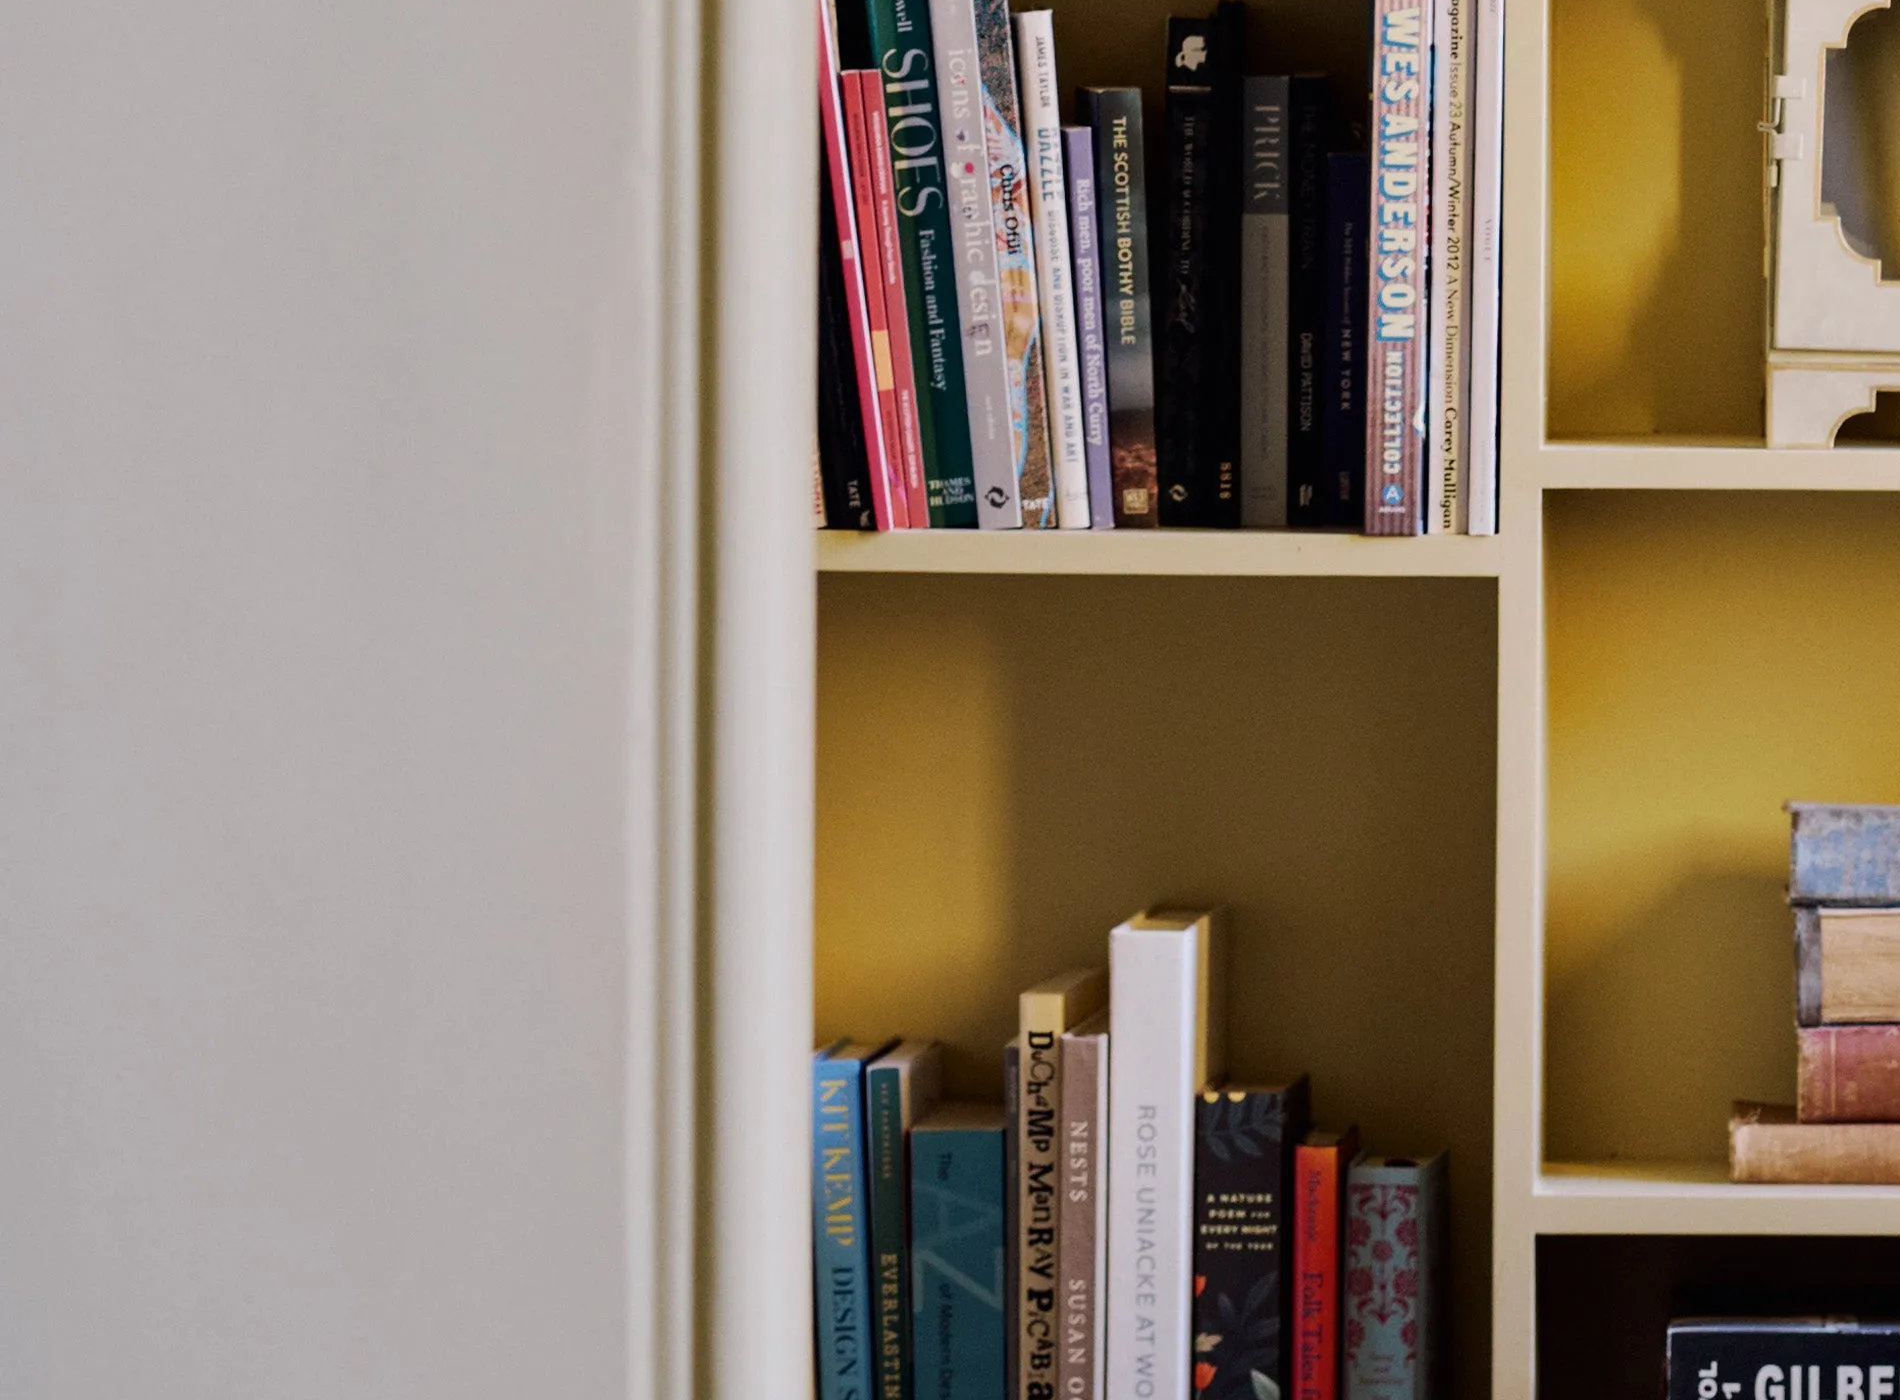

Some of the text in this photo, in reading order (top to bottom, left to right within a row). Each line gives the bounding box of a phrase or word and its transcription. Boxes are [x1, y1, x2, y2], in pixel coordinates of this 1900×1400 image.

[1448, 61, 1464, 100] Issue
[881, 47, 945, 218] SHOES
[1448, 100, 1464, 119] 23
[1252, 104, 1281, 200] PRICK
[1373, 7, 1422, 343] WES ANDERSON
[1075, 178, 1093, 212] Rich
[1444, 121, 1463, 234] Autumn/Winter
[998, 164, 1022, 256] Chris Ofili
[1112, 116, 1137, 345] THE SCOTTISH BOTHY BIBLE
[917, 229, 942, 291] Fashion
[1076, 256, 1096, 299] poor
[1445, 236, 1460, 271] 2012
[1445, 288, 1459, 321] New
[1446, 273, 1459, 286] A
[926, 295, 943, 326] and
[1084, 296, 1097, 331] men
[924, 328, 950, 392] Fantasy
[1086, 333, 1103, 351] of
[1340, 329, 1353, 361] NEW
[1444, 324, 1460, 404] Dimension
[1087, 353, 1105, 399] North
[1340, 369, 1353, 412] YORK
[1087, 402, 1105, 446] Curry
[1382, 350, 1405, 474] COLLECTION
[1440, 407, 1458, 455] Carey
[846, 479, 859, 508] TATE
[1439, 458, 1457, 530] Mulligan
[818, 1079, 850, 1141] KIT
[1068, 1119, 1090, 1203] NESTS
[1135, 1104, 1158, 1178] ROSE
[820, 1148, 856, 1247] KEMP
[1135, 1185, 1157, 1310] UNIACKE
[829, 1267, 859, 1376] DESIGN
[1066, 1278, 1086, 1366] SUSAN
[1301, 1271, 1325, 1323] Folk
[1136, 1314, 1156, 1346] AT
[1301, 1328, 1323, 1372] Tales
[1721, 1381, 1742, 1400] 1
